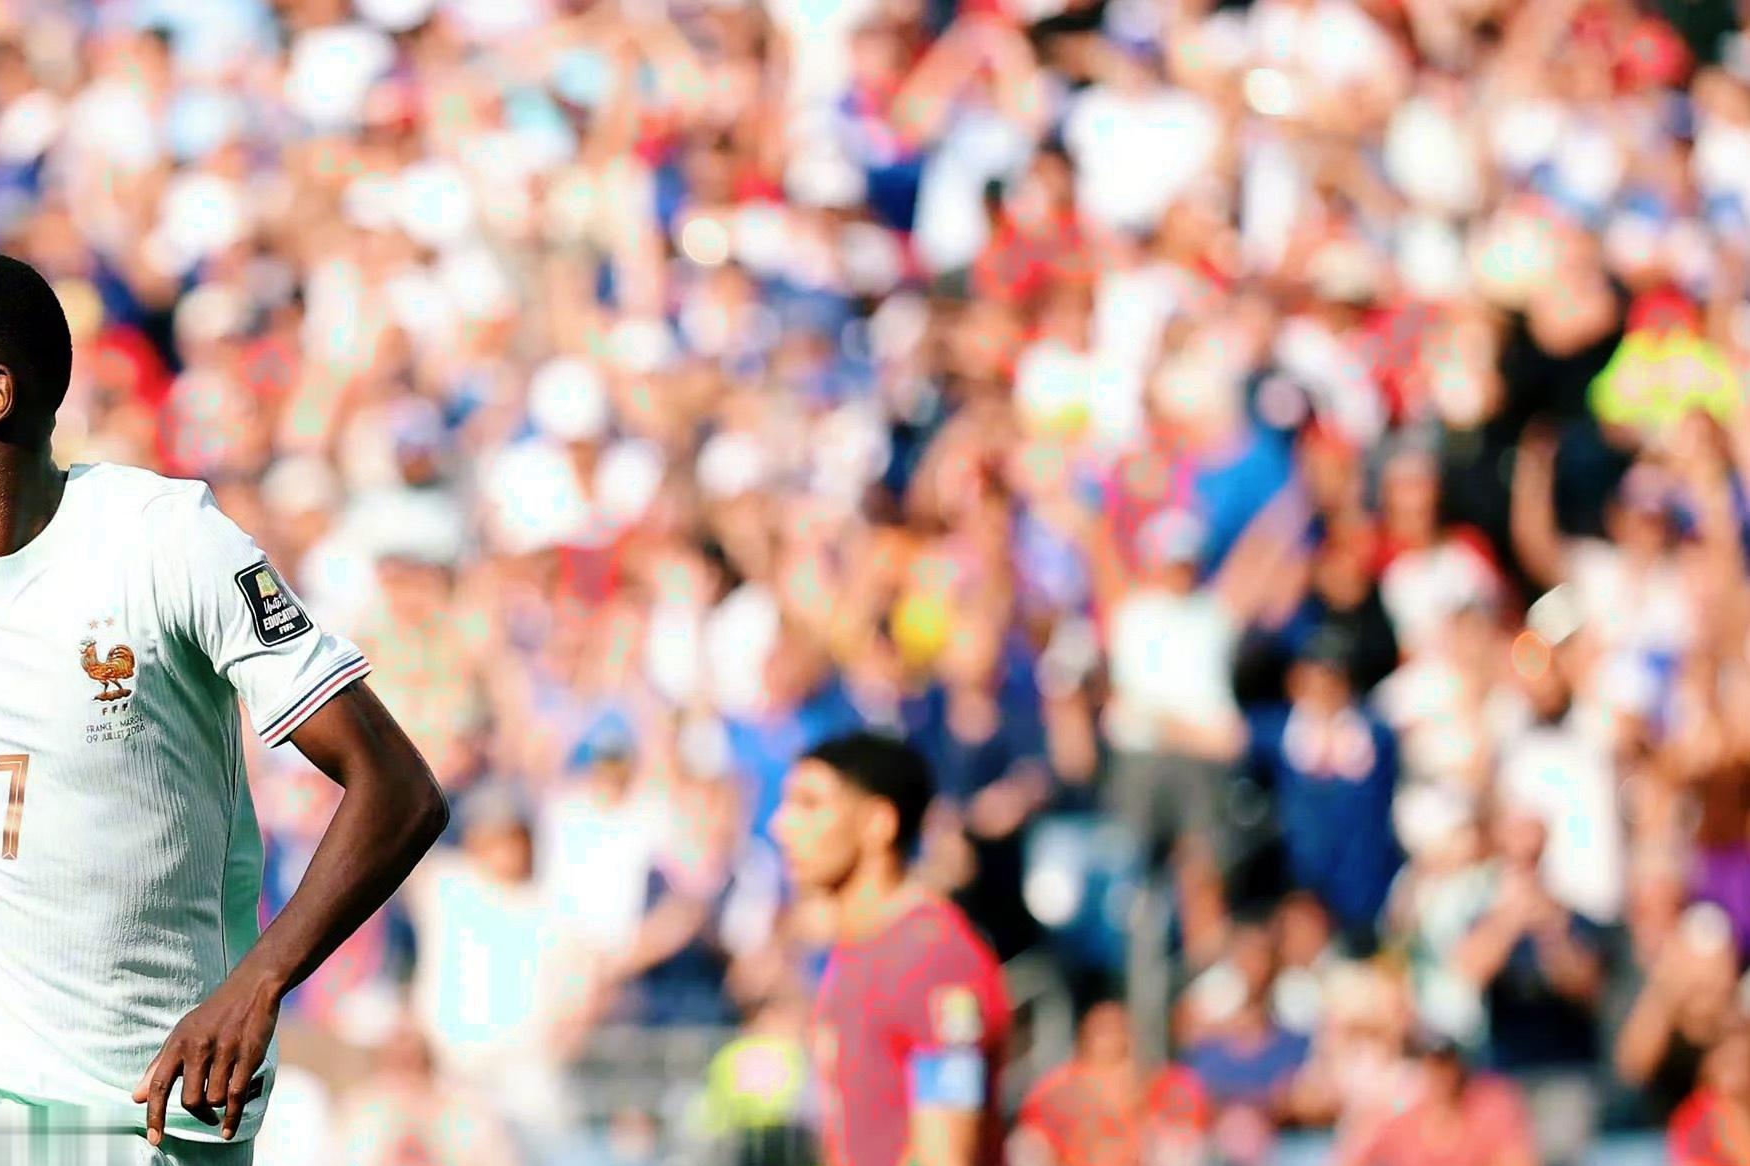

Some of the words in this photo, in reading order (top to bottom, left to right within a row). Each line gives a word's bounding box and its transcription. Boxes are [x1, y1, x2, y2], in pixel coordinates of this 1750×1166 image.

[279, 622, 295, 634] FIFA
[86, 722, 112, 733] FRANCE
[120, 713, 144, 726] MAROC
[86, 734, 99, 744] 09
[102, 729, 124, 742] JUILLET
